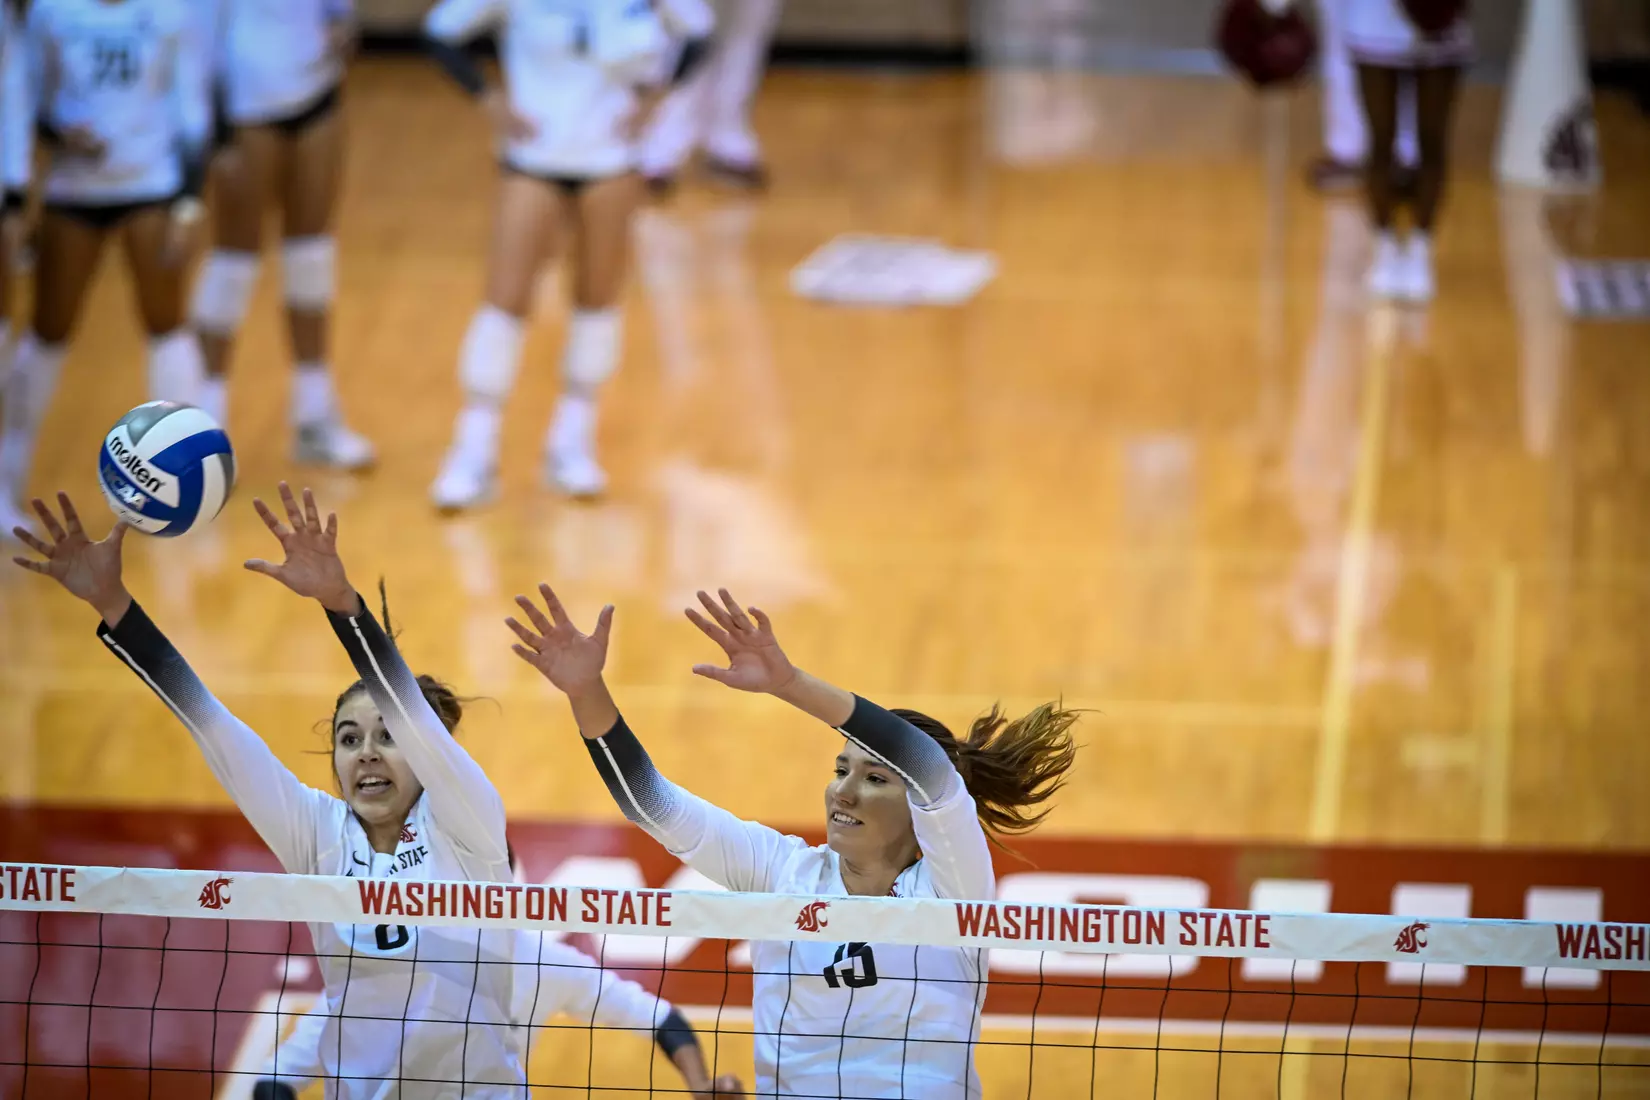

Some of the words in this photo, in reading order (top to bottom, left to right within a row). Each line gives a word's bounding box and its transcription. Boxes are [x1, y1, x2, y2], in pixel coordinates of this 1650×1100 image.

[109, 436, 164, 493] molten
[0, 865, 75, 902] TATE
[358, 880, 567, 922] WASHINGTON
[581, 888, 672, 926] STATE
[955, 902, 1166, 945] WASHINGTON
[1178, 911, 1271, 949] STATE
[1555, 924, 1650, 961] WASH
